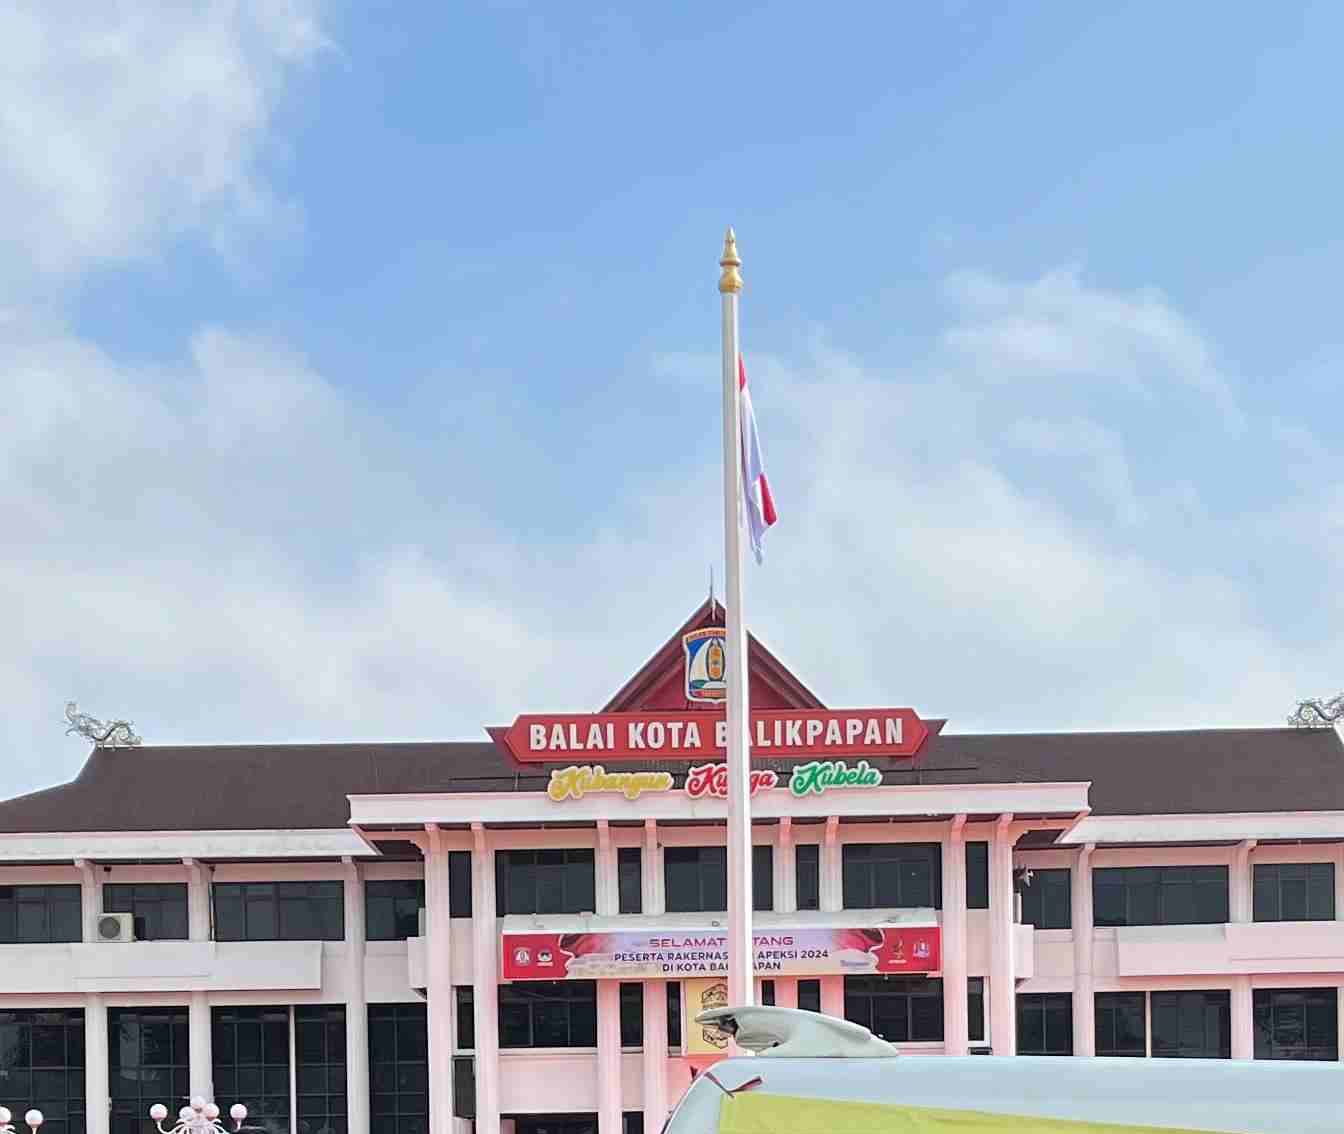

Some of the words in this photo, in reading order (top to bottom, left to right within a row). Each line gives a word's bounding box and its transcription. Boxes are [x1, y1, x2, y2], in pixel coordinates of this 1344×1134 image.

[529, 723, 615, 750] BALAI
[628, 721, 702, 749] KOTA
[715, 717, 903, 748] BLIKPAPAN
[685, 763, 778, 799] Kuga
[790, 760, 883, 797] Kubela
[649, 937, 728, 948] SELAMAT
[752, 936, 794, 946] TANG
[614, 952, 664, 962] PESERTA
[667, 951, 728, 961] RAKERNAS
[758, 950, 798, 960] APEKSI
[800, 949, 829, 959] 2024
[676, 962, 707, 972] KOTA
